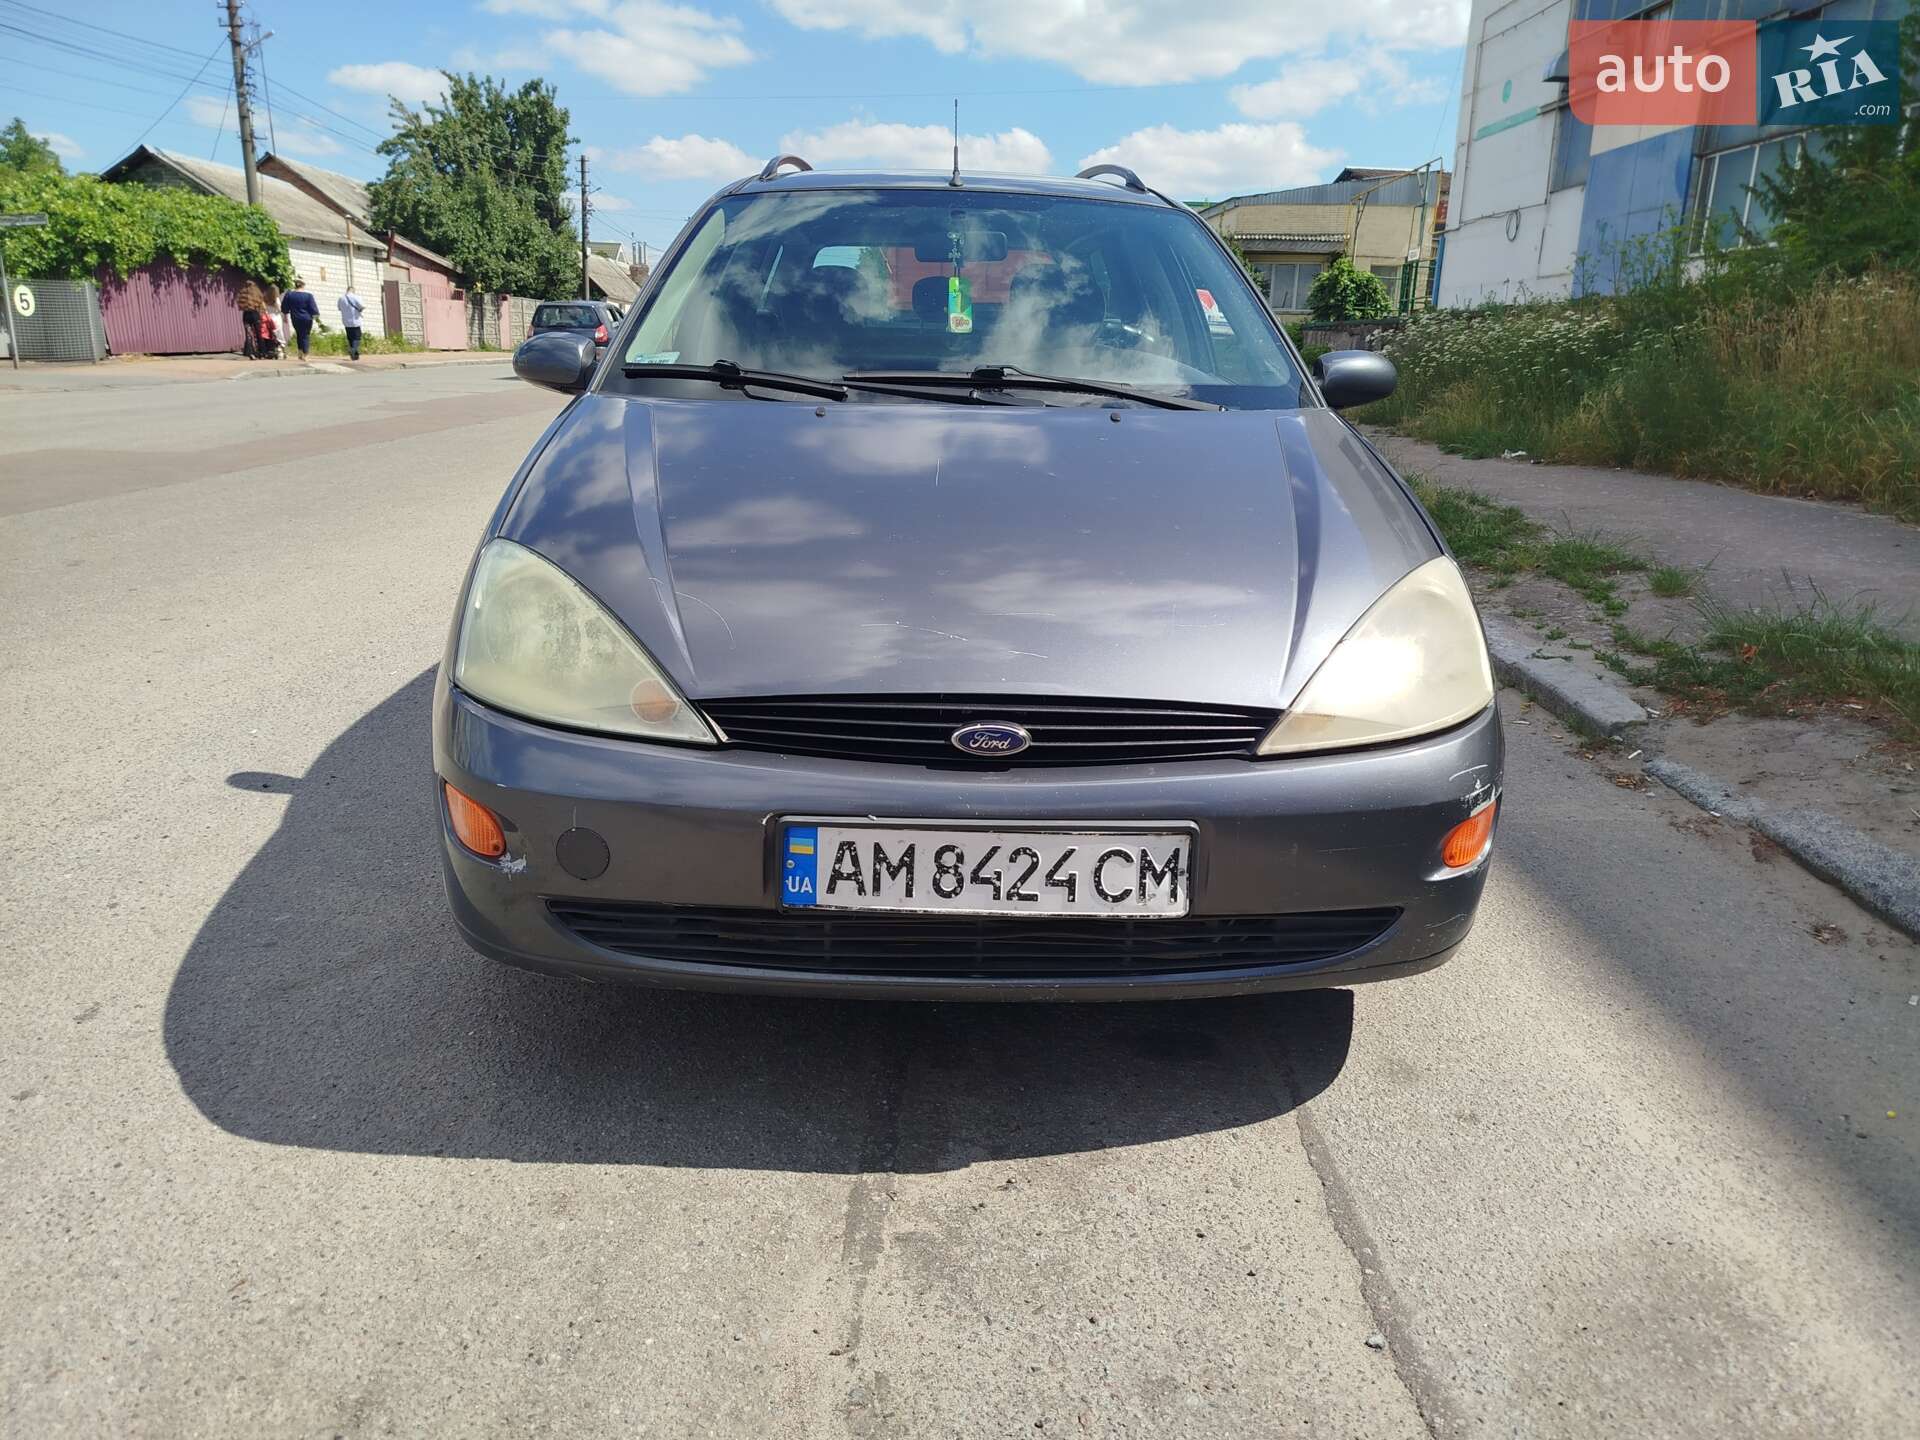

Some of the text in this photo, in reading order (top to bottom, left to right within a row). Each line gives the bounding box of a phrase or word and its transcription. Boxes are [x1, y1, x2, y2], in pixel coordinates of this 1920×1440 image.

[19, 292, 30, 311] 5
[969, 731, 1012, 750] Ford
[826, 841, 1181, 904] AM 8424 CM
[788, 875, 813, 893] UA
